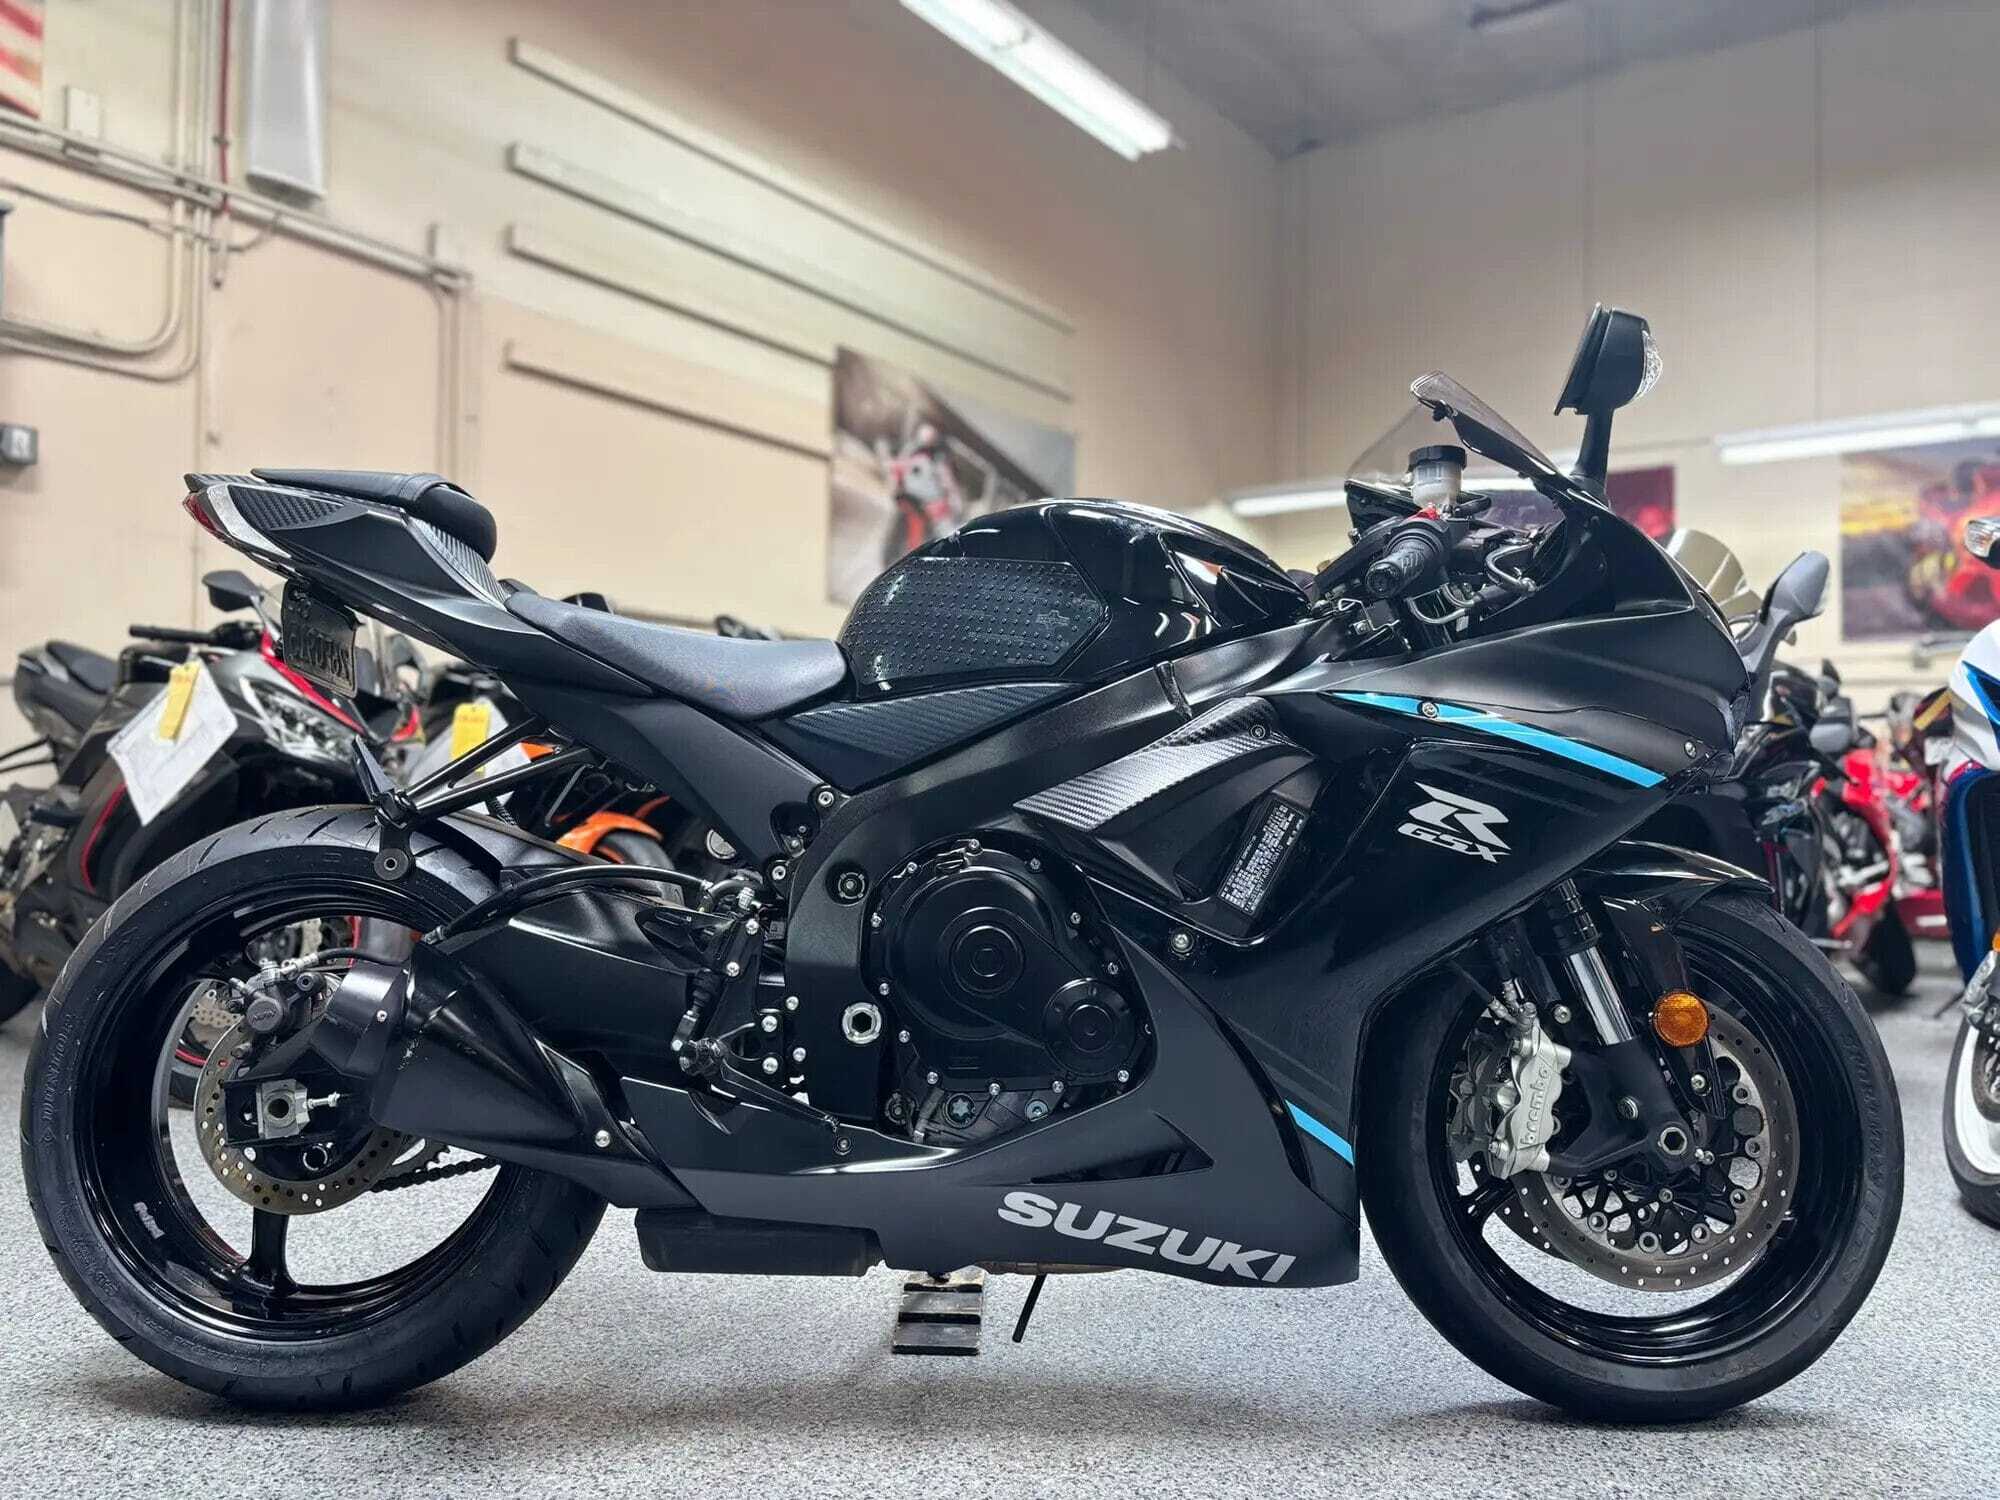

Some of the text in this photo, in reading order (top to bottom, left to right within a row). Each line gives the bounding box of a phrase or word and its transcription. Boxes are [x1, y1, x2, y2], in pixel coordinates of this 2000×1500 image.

[1398, 822, 1510, 863] GSX
[1520, 1066, 1549, 1145] brembo
[998, 1191, 1297, 1283] SUZUKI
